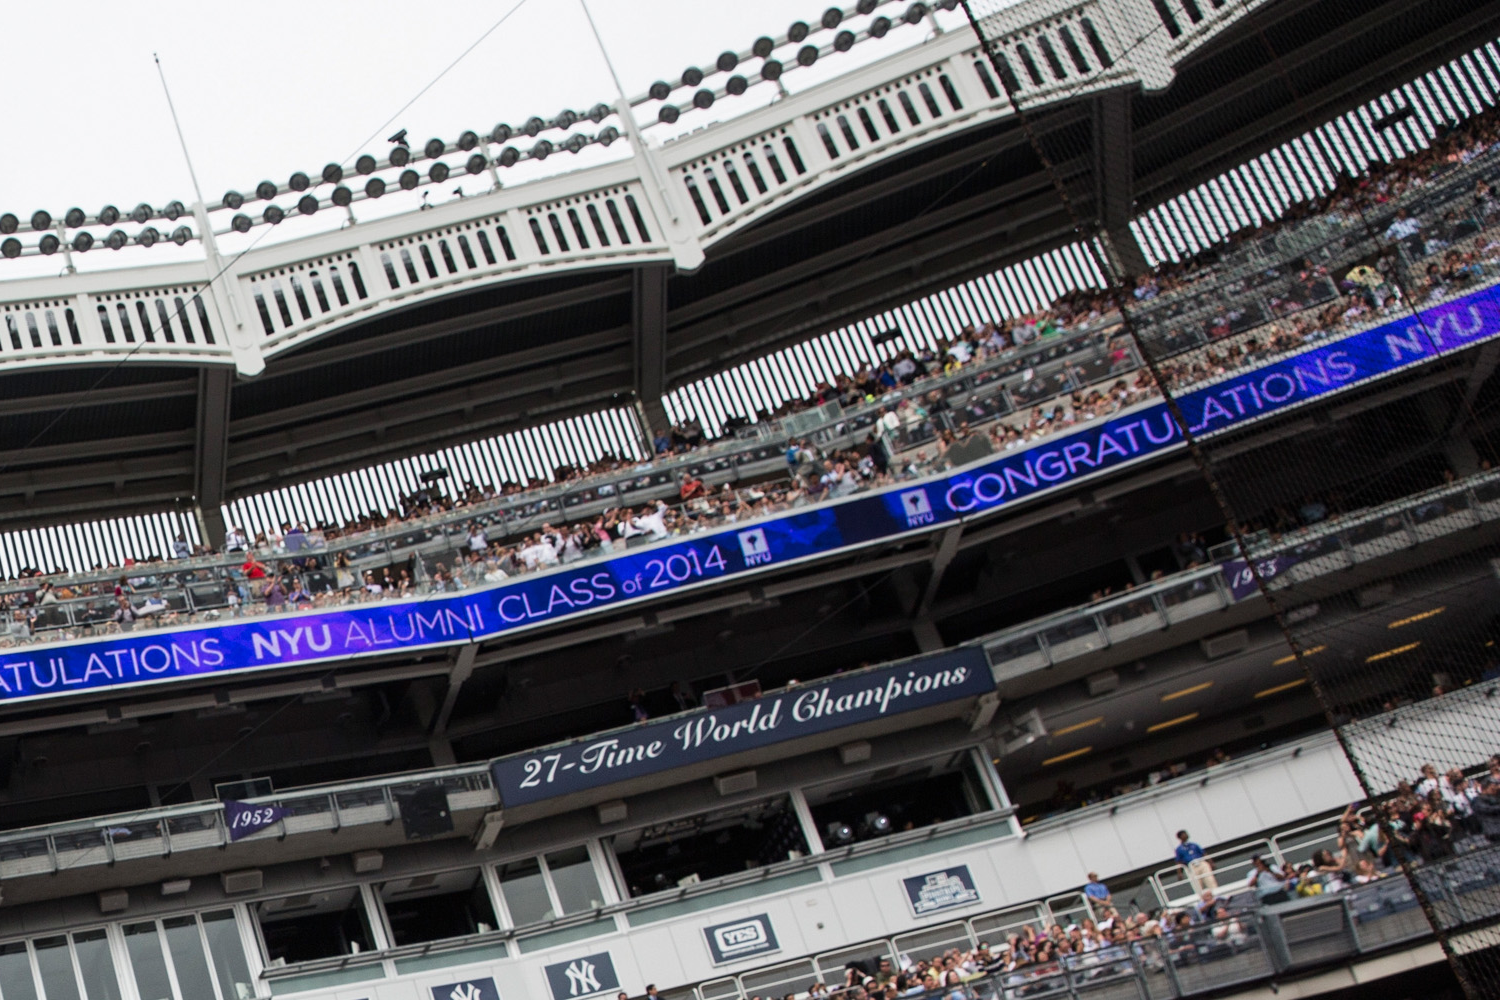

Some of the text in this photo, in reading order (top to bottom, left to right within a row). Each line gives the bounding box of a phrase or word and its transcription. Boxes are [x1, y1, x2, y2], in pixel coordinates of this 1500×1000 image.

[1383, 303, 1484, 361] NYU
[906, 510, 935, 528] NYU
[743, 550, 773, 566] NYU
[252, 625, 332, 660] NYU
[344, 603, 485, 648] ALUMNI
[498, 572, 616, 624] CLASS
[621, 572, 643, 595] of
[643, 546, 727, 590] 2014
[519, 664, 973, 789] 27-Time World Champions
[232, 808, 274, 828] 1952
[564, 959, 601, 996] NY
